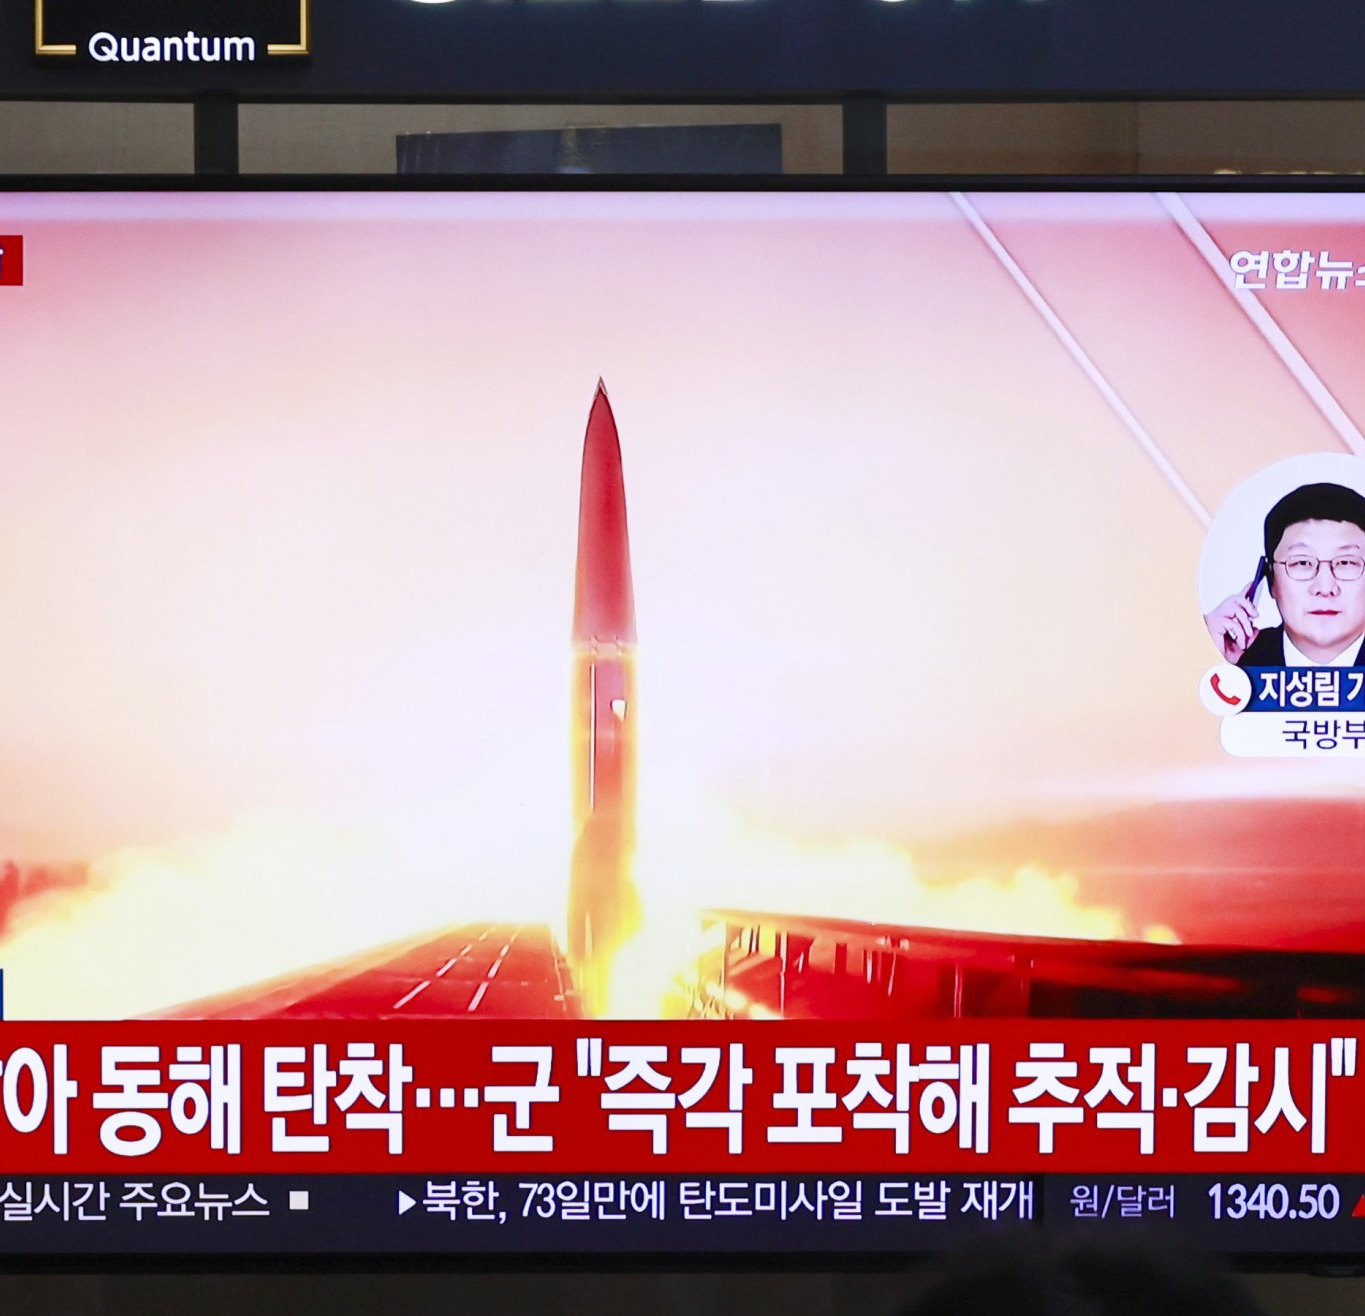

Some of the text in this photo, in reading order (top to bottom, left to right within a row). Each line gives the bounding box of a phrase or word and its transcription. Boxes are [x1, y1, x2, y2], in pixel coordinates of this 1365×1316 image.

[89, 31, 254, 61] Quantum
[1259, 671, 1339, 707] 지성림
[93, 1044, 240, 1156] 동해
[577, 1038, 752, 1154] "즉각
[768, 1043, 989, 1153] 포착해
[120, 1182, 269, 1221] 주요뉴스
[423, 1181, 506, 1224] 북한,
[519, 1181, 664, 1220] 73일만에
[680, 1181, 861, 1220] 탄도미사일
[875, 1181, 950, 1219] 도발
[961, 1181, 1032, 1220] 재개
[1071, 1185, 1173, 1217] 원/달러
[1209, 1184, 1339, 1218] 1340.50
